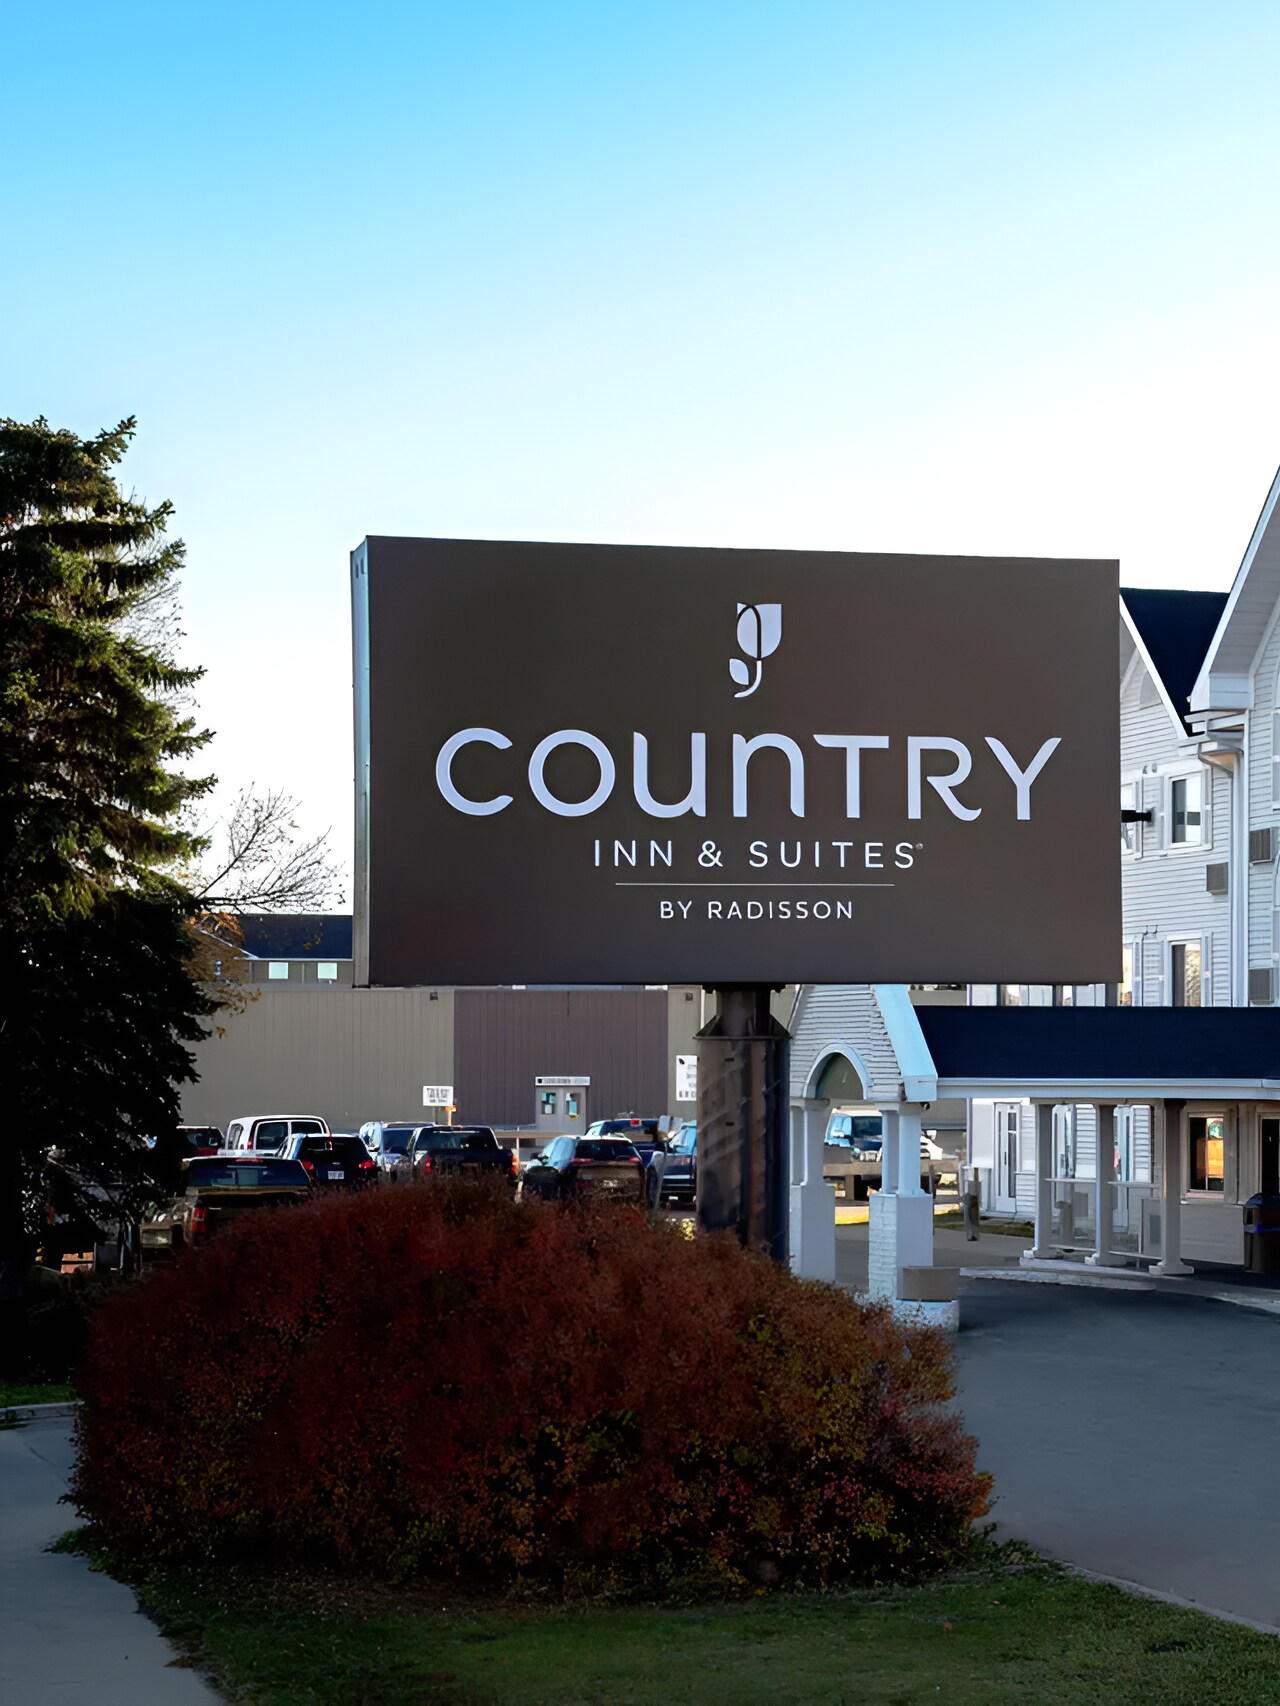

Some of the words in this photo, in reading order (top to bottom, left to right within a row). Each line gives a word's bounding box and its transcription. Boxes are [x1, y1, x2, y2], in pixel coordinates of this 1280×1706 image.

[435, 727, 1063, 822] COUNTRY
[593, 839, 673, 867] INN
[697, 840, 724, 868] &
[660, 900, 693, 920] BY
[707, 900, 853, 920] RADISSON
